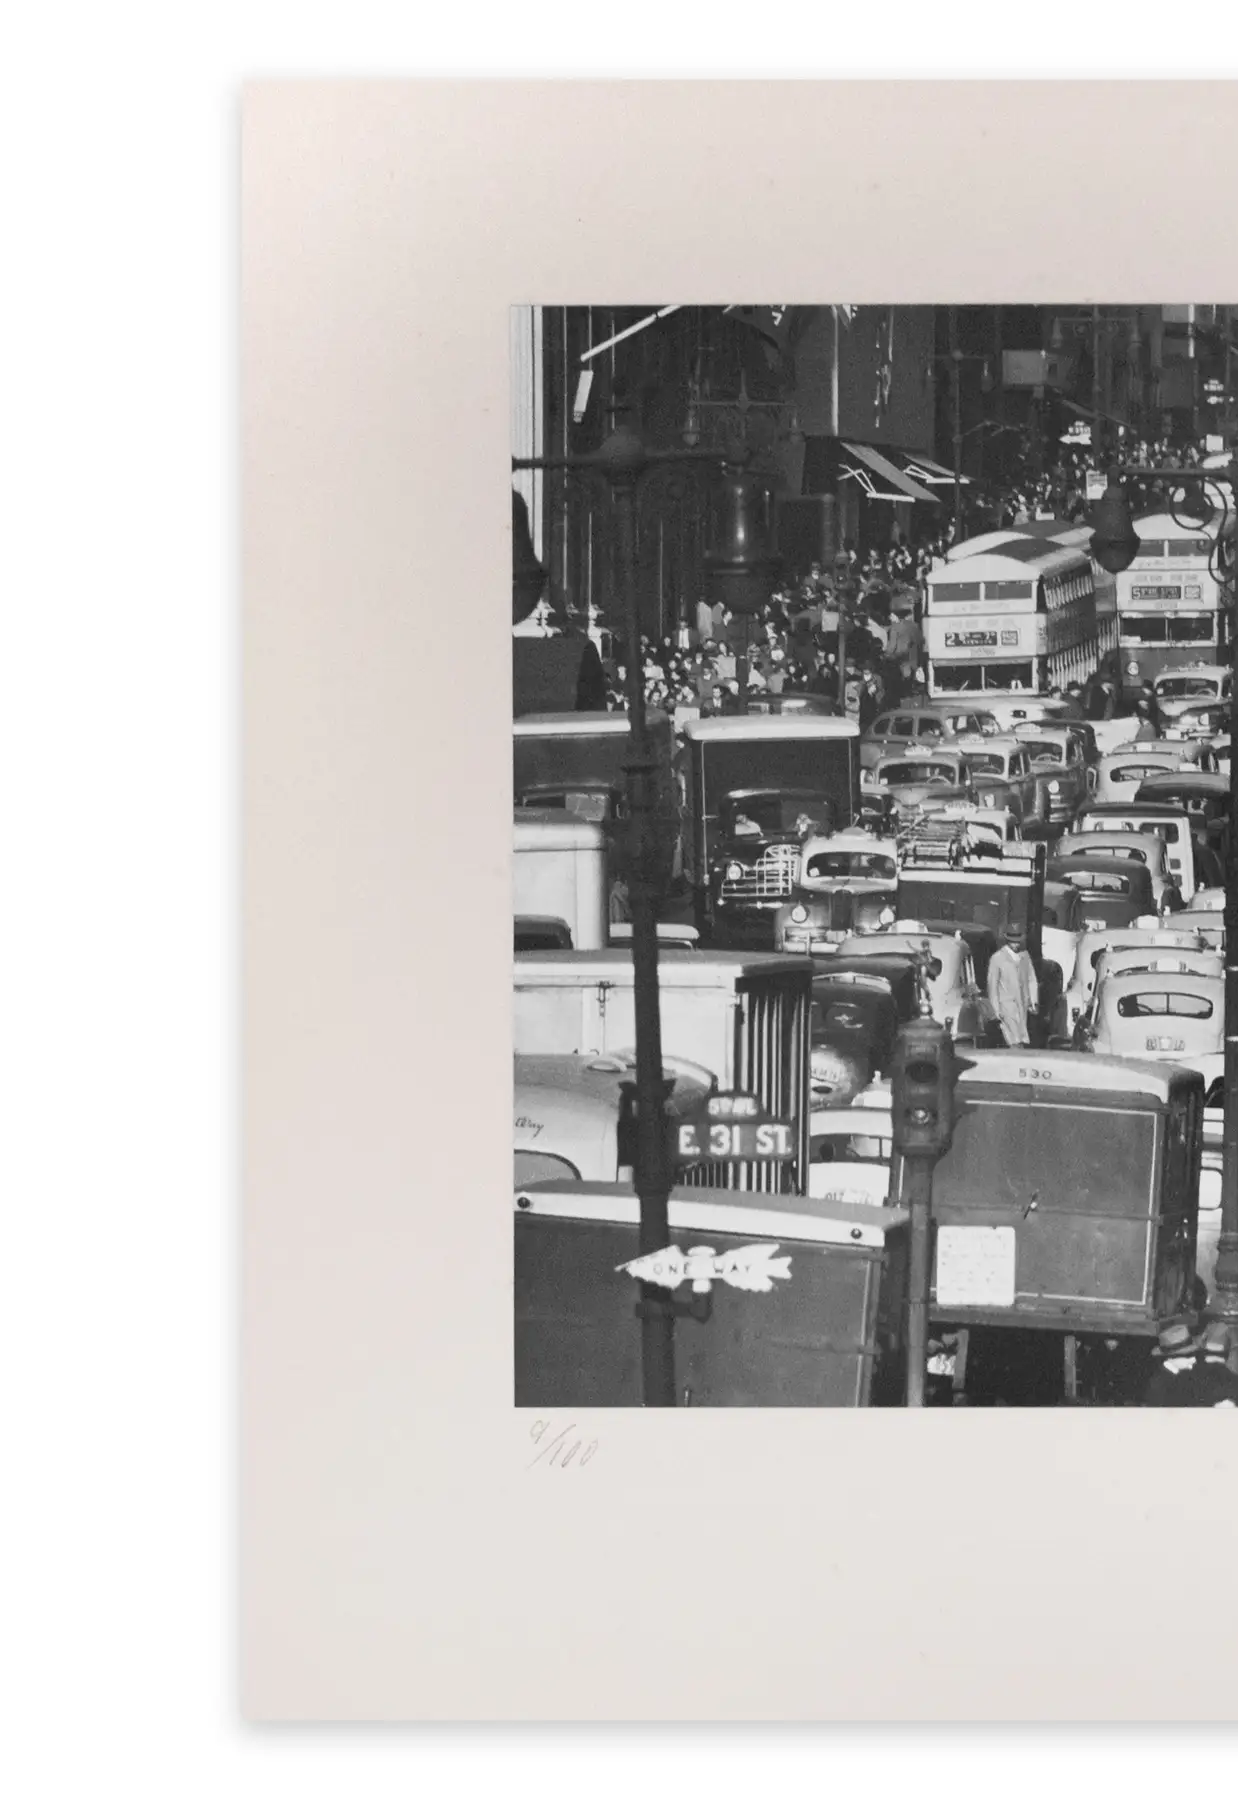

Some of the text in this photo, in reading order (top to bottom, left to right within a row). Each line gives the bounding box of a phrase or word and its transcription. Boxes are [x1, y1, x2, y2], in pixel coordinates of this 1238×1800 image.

[1018, 1067, 1053, 1080] 530
[710, 1123, 741, 1156] 31
[653, 1261, 752, 1276] ONE WAY
